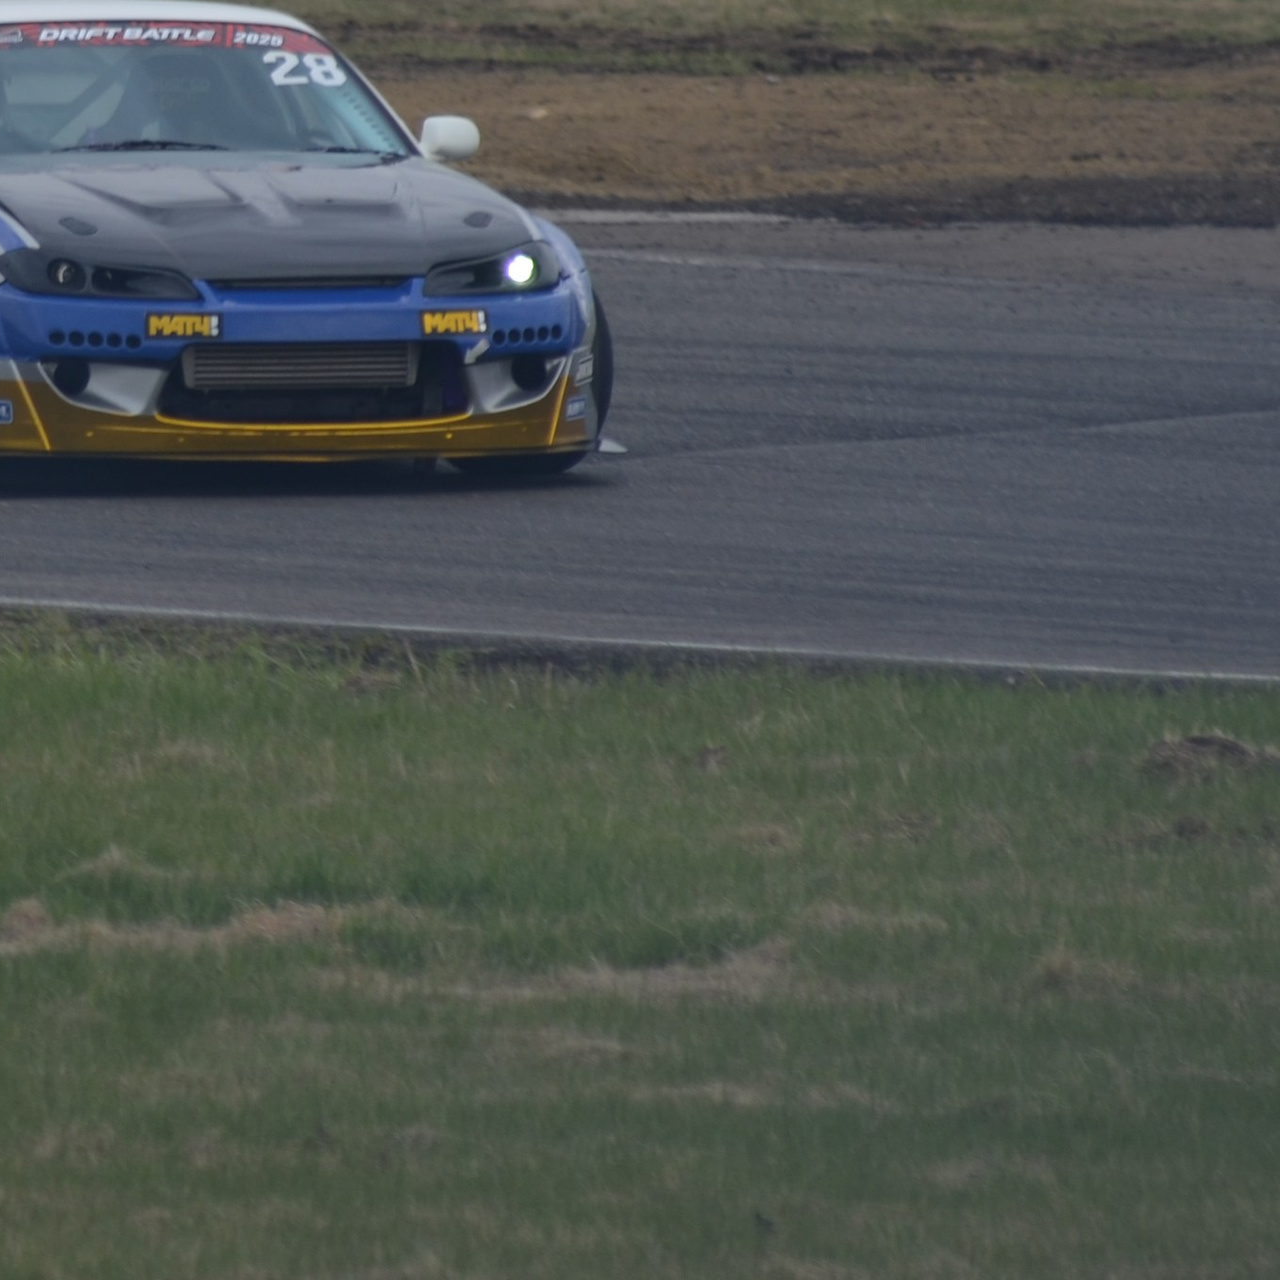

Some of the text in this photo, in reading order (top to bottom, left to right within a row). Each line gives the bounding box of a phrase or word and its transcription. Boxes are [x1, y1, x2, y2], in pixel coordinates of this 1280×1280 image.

[39, 27, 122, 41] DRIFT
[123, 27, 216, 42] BATTLE
[262, 49, 348, 87] 28
